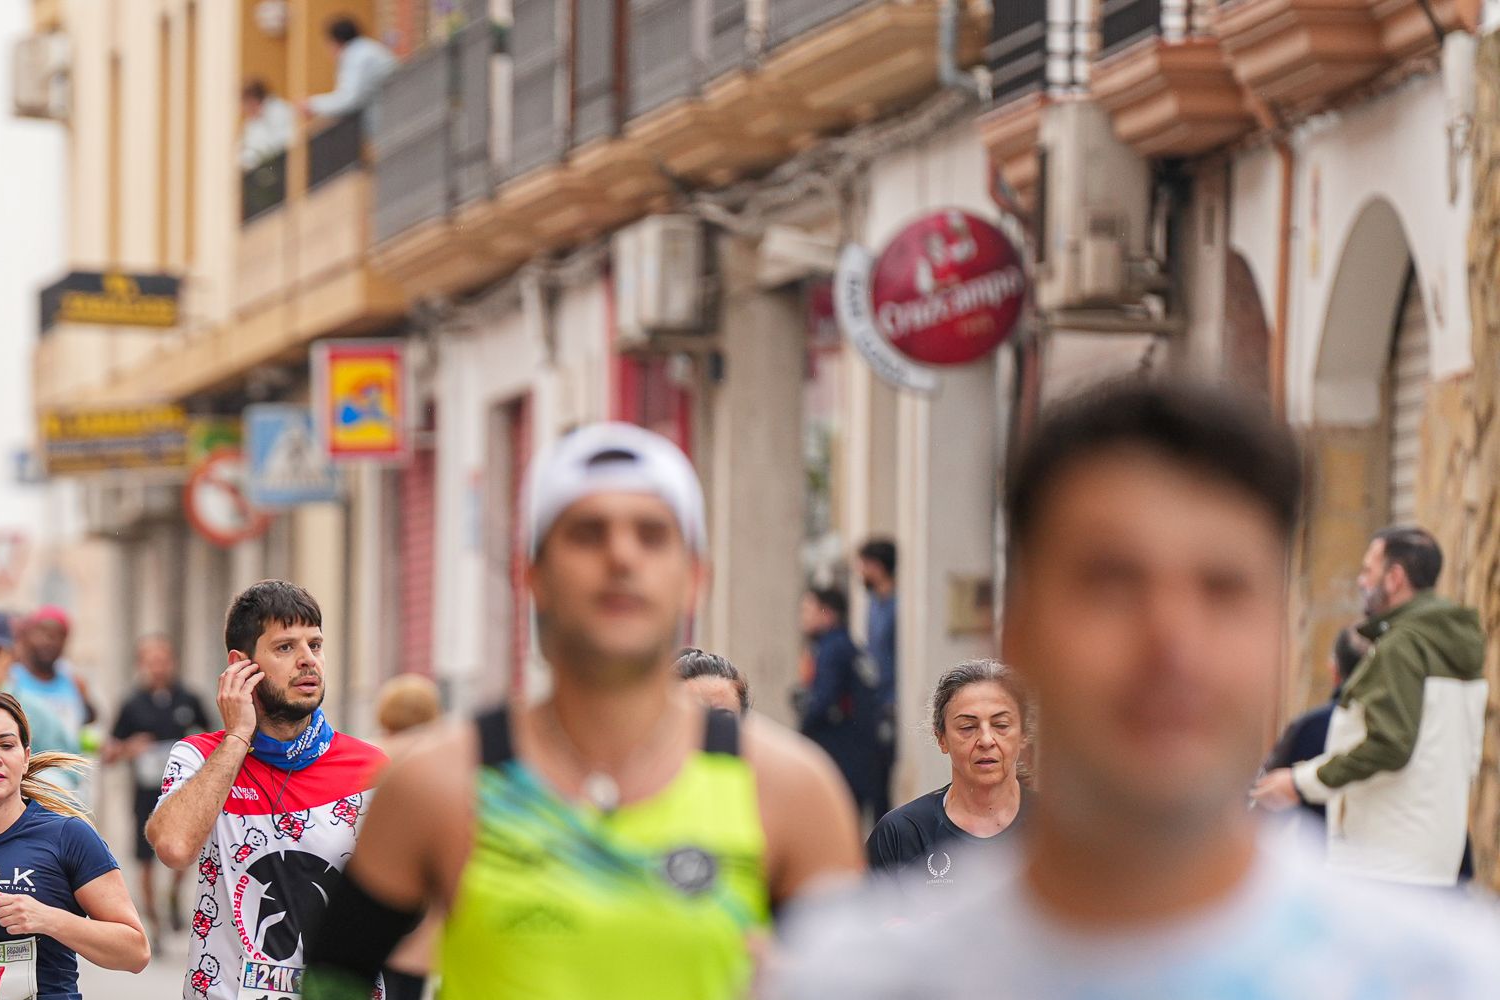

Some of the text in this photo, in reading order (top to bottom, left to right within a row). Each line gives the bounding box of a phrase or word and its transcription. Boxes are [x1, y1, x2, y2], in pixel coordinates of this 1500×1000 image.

[242, 787, 256, 795] RUN
[245, 793, 259, 801] PRO
[233, 875, 254, 953] GUERREROS
[257, 964, 295, 993] 21K
